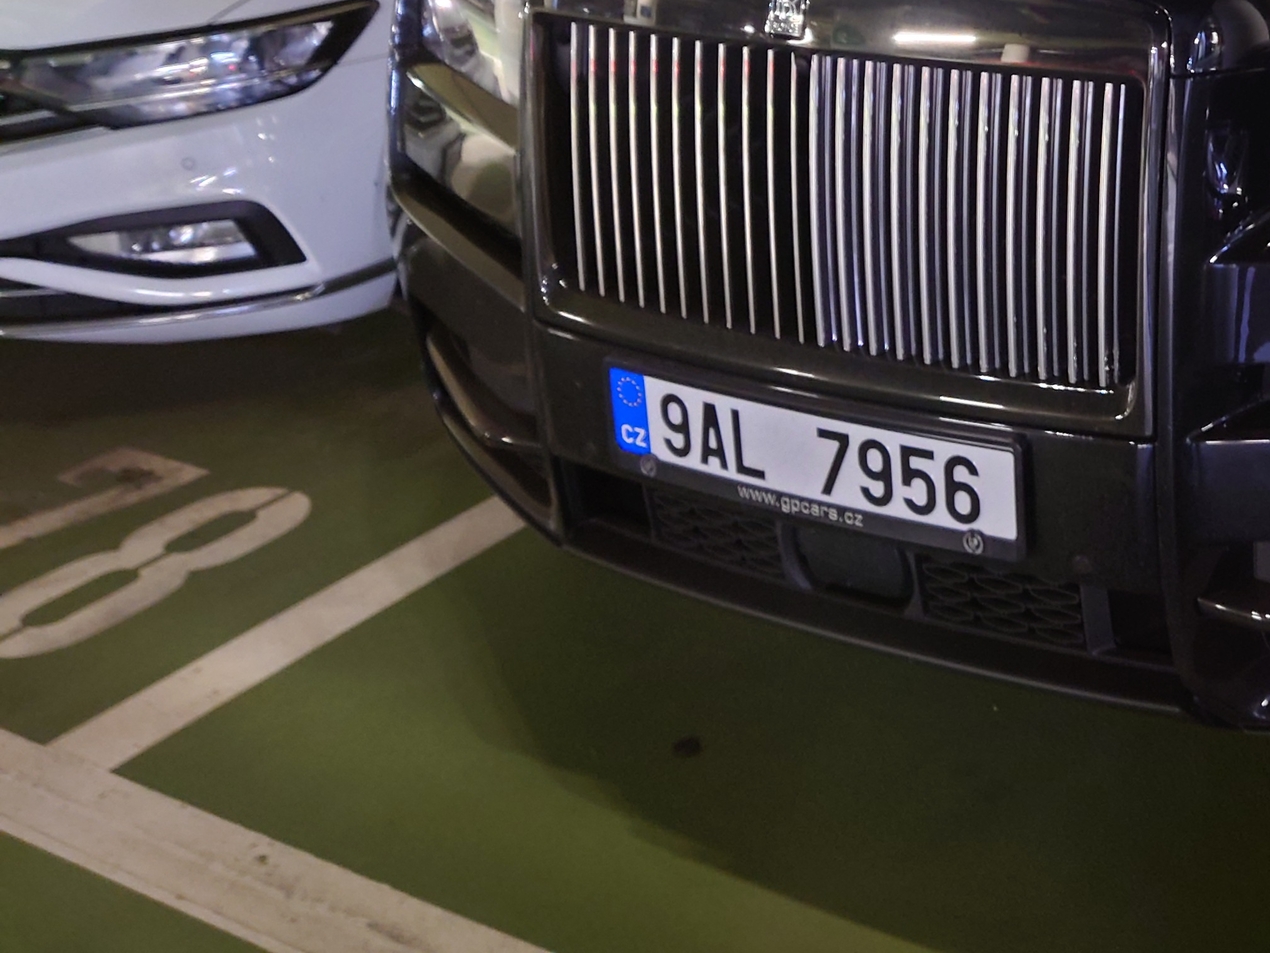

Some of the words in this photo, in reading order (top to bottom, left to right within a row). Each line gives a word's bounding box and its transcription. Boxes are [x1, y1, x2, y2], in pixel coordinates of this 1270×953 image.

[620, 422, 647, 448] CZ
[660, 393, 766, 479] 9AL
[816, 427, 981, 524] 7956
[737, 484, 865, 527] www.gpcars.cz
